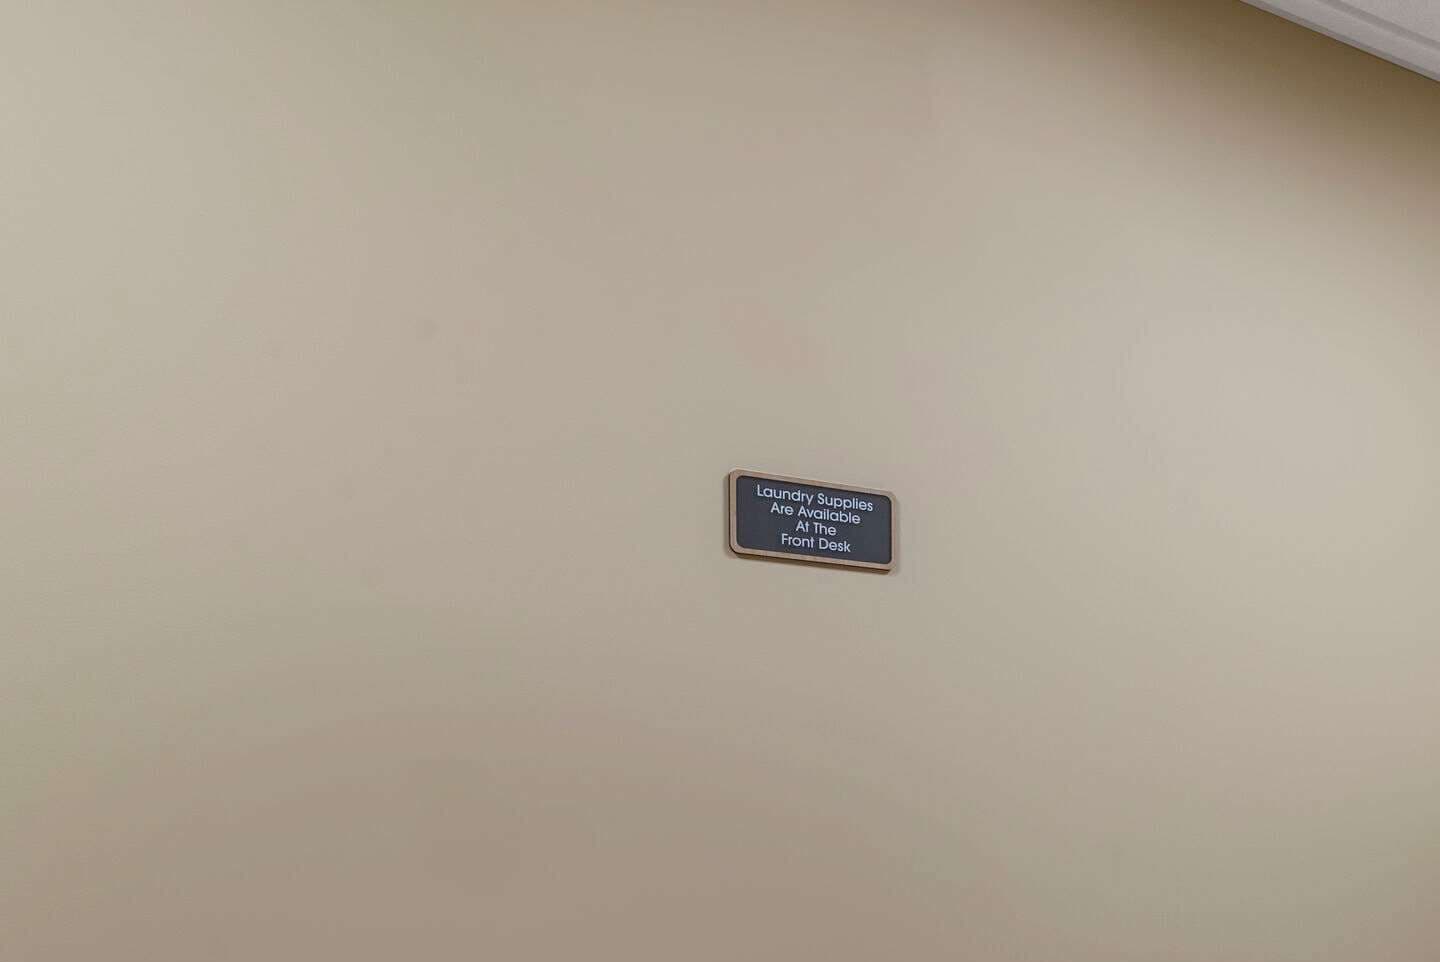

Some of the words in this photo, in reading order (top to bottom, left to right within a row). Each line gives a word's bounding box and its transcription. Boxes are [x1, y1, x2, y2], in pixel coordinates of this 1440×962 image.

[756, 484, 814, 505] Laundry
[817, 492, 873, 512] Supplies
[770, 502, 794, 516] Are
[797, 506, 861, 524] Available
[795, 521, 809, 533] At
[813, 522, 837, 536] The
[781, 533, 814, 549] Front
[818, 537, 851, 553] Desk
